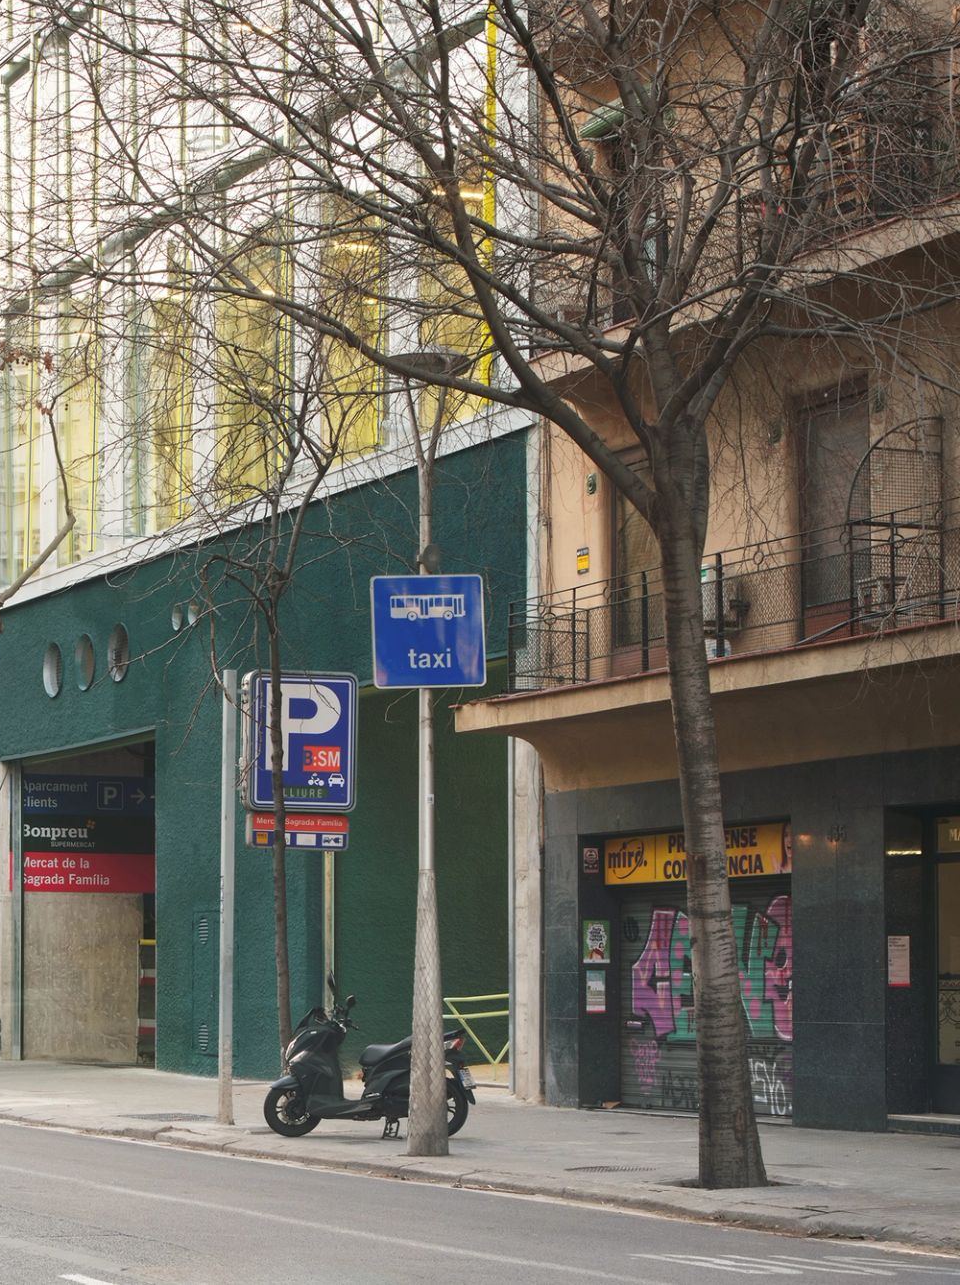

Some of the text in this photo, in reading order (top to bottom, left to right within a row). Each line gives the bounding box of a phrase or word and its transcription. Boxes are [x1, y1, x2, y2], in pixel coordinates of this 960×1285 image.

[408, 648, 451, 669] taxi
[265, 683, 341, 772] P
[24, 780, 88, 793] Aparcament
[103, 787, 118, 805] P
[285, 817, 315, 826] Sagrada
[24, 824, 88, 840] Bonpreu
[24, 857, 90, 869] Mercat de la
[24, 874, 110, 887] Sagrada Família
